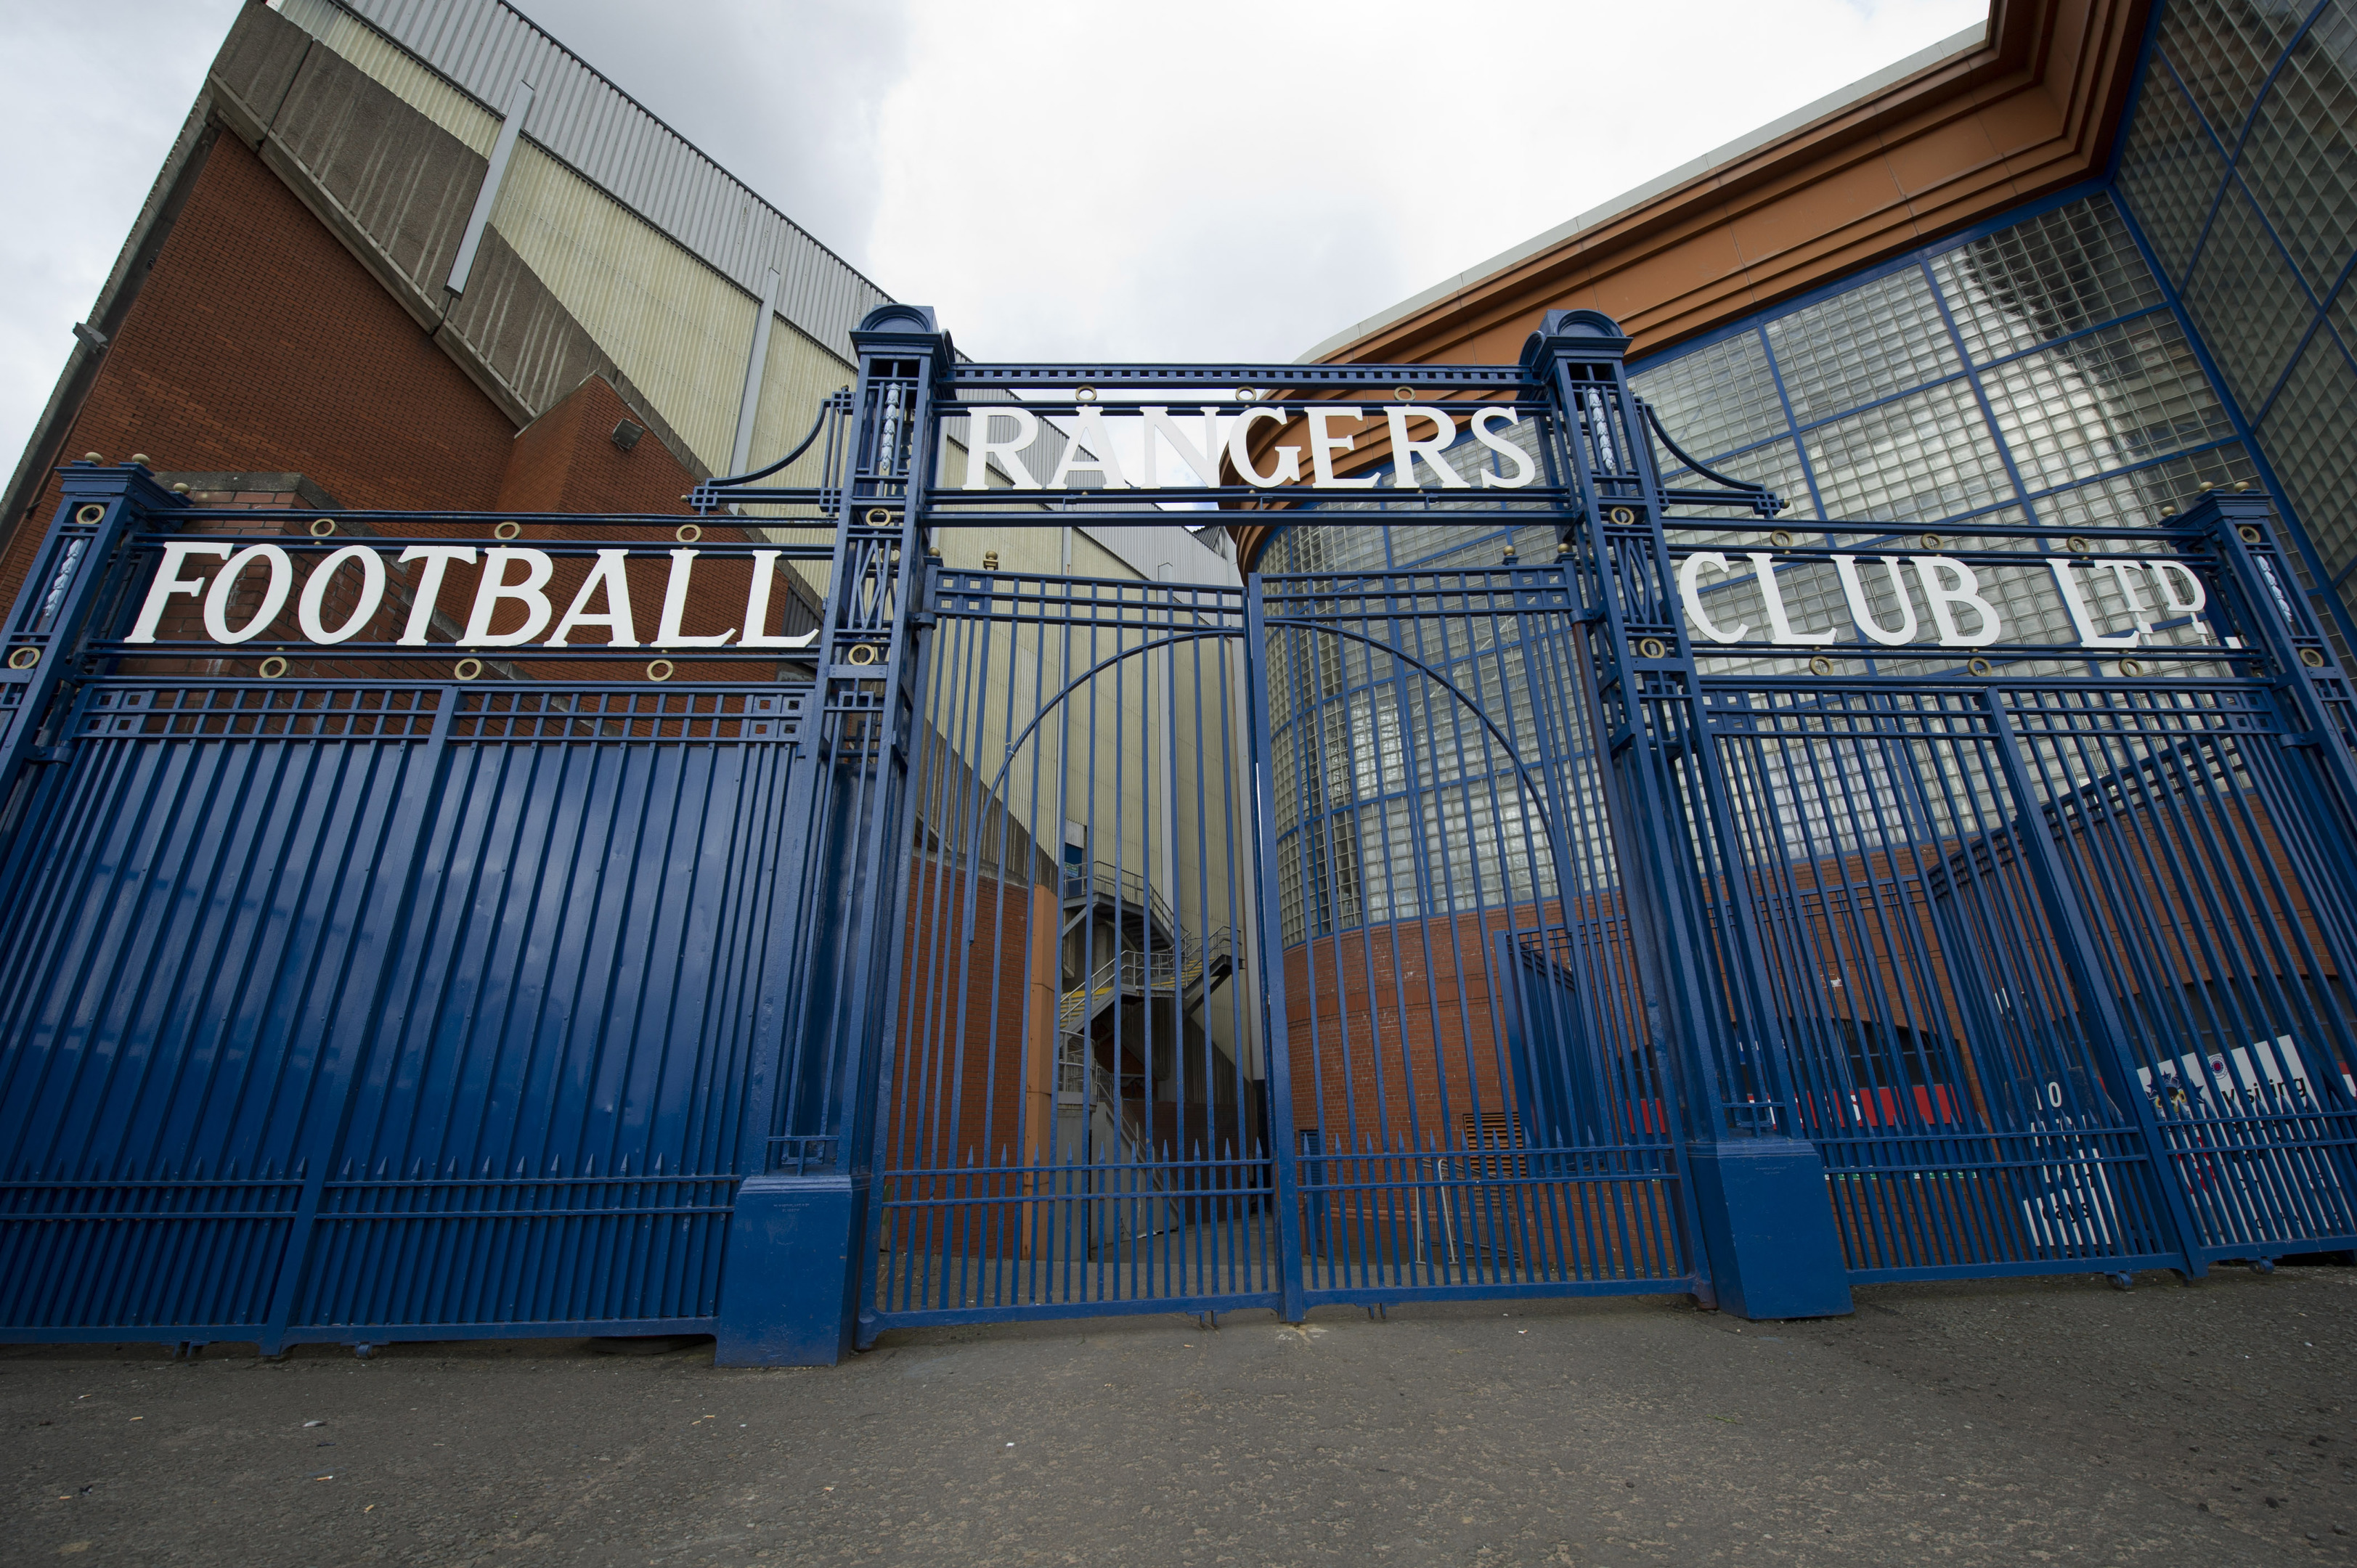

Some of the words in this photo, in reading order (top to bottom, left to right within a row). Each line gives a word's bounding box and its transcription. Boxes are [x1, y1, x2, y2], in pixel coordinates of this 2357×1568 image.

[961, 406, 1536, 491] RANGERS
[123, 541, 819, 648] FOOTBALL
[1679, 552, 2002, 648] CLUB
